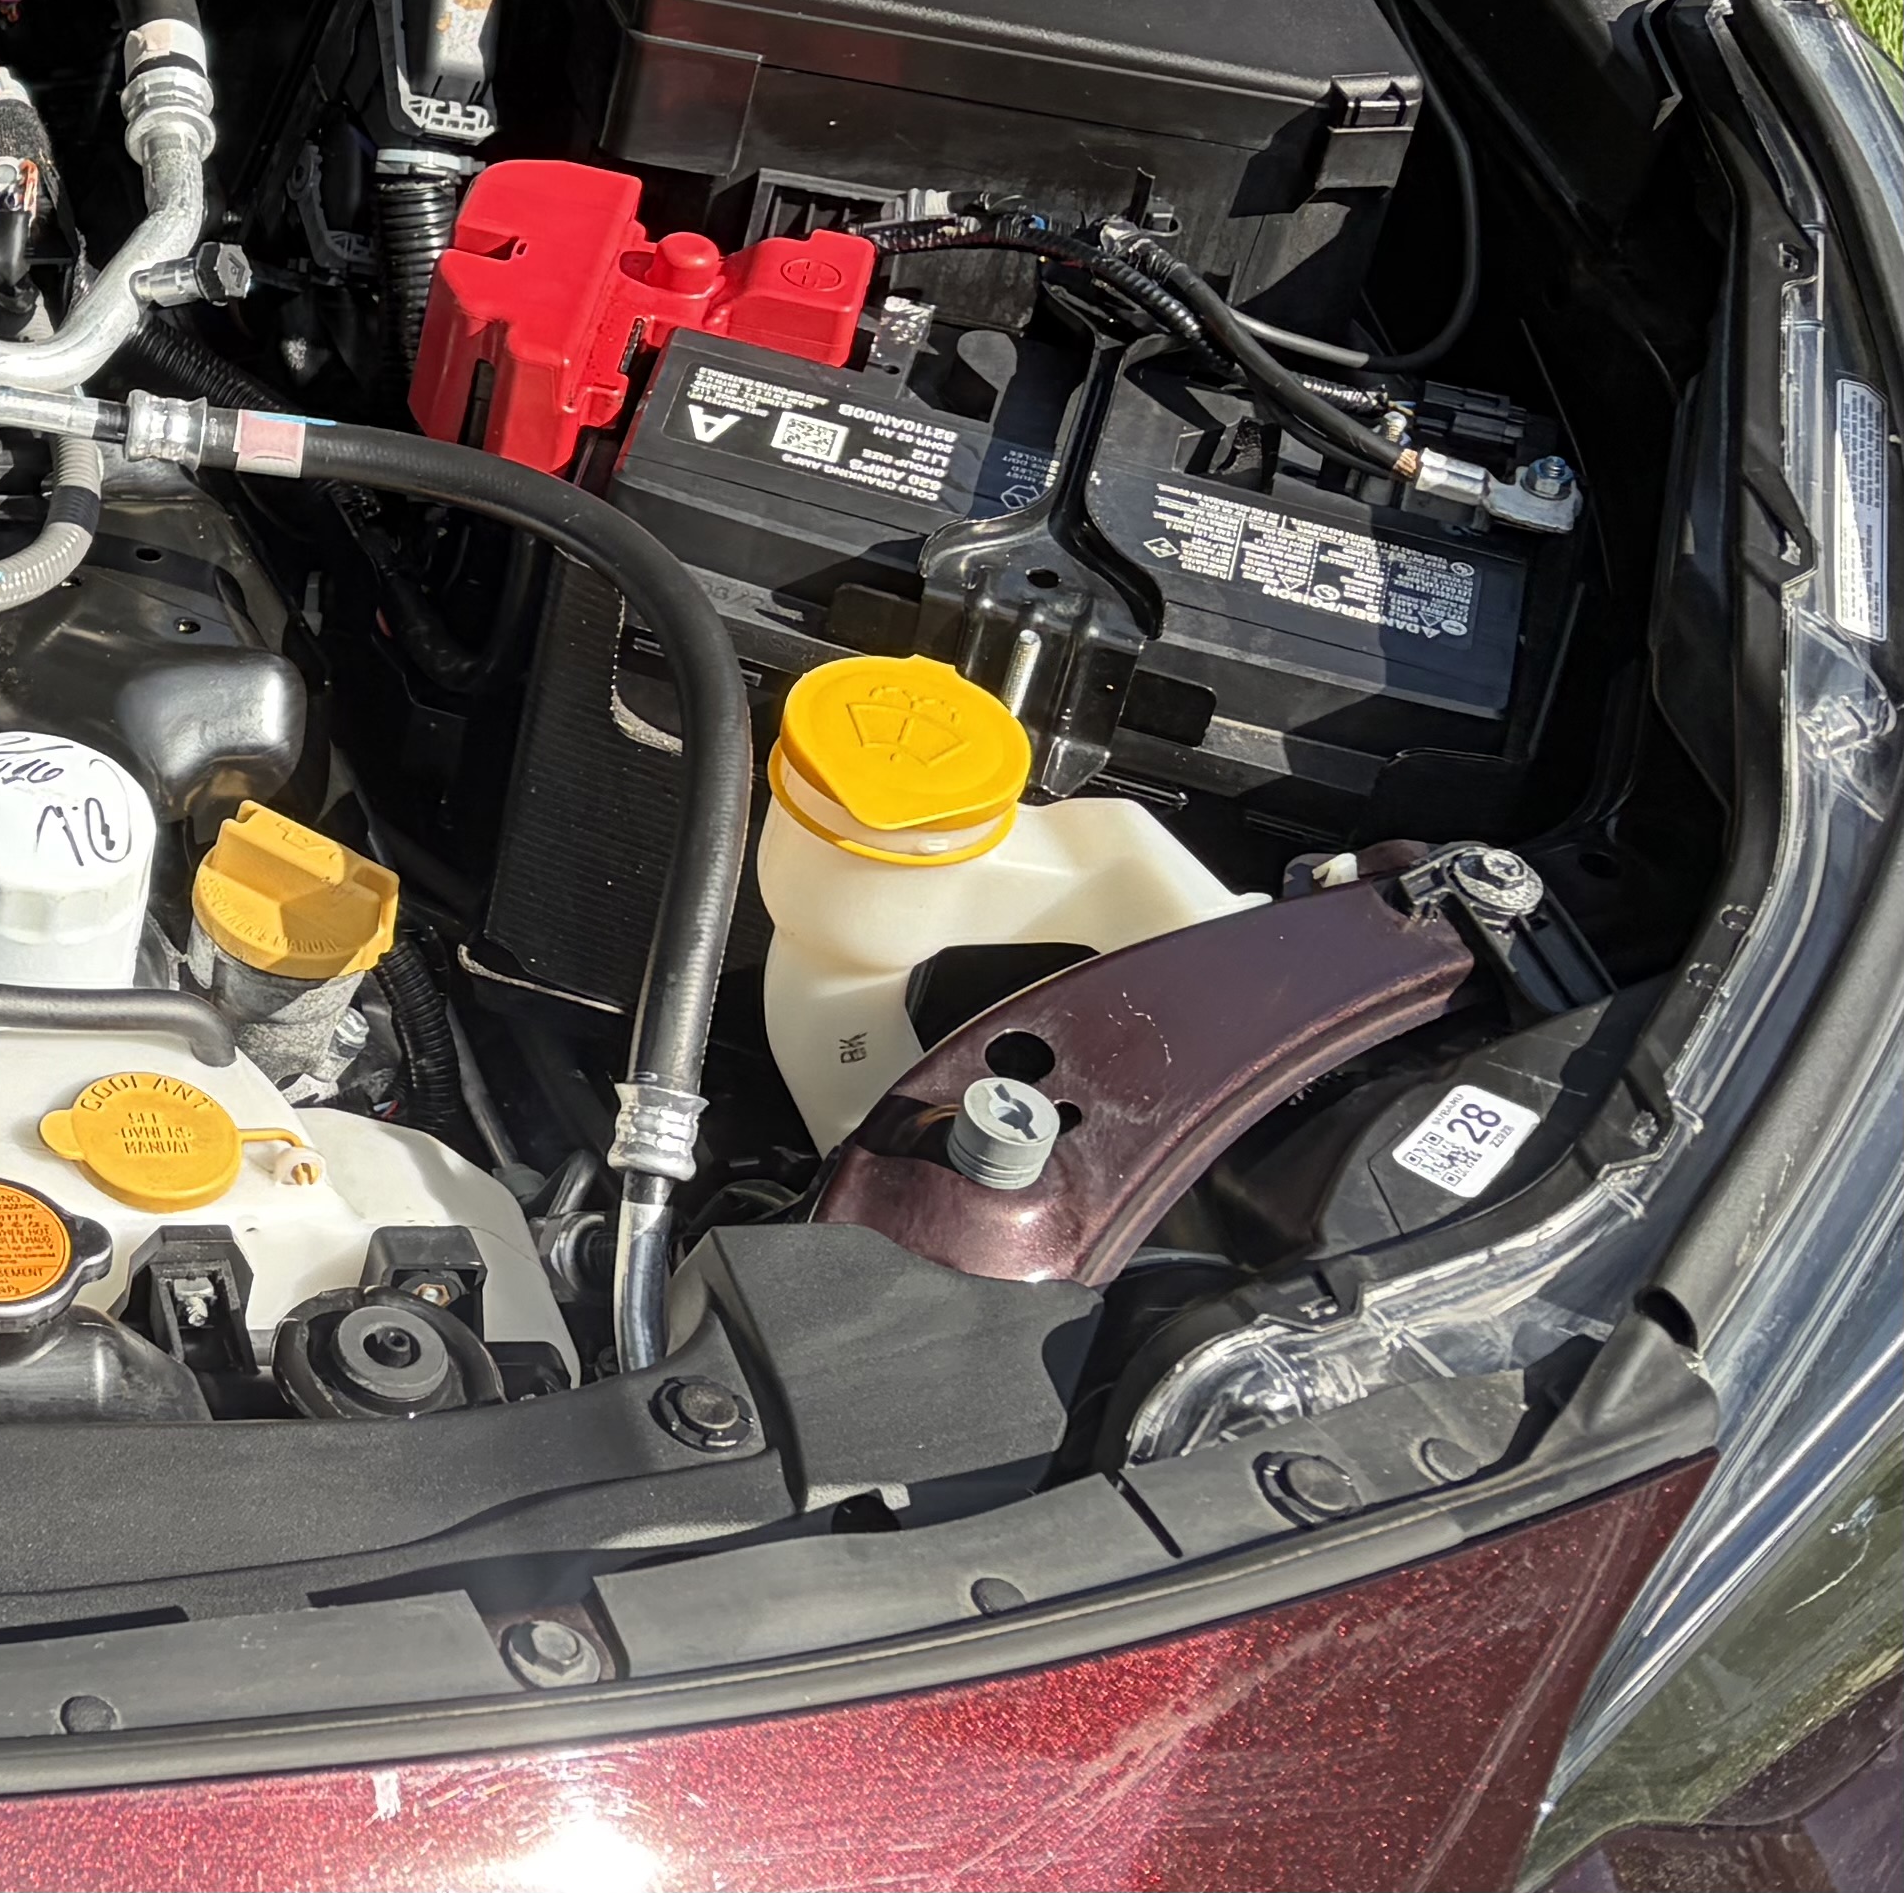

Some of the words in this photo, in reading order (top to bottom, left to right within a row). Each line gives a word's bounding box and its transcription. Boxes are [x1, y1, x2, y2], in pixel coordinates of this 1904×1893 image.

[688, 403, 742, 442] A
[823, 464, 896, 490] CRANKING
[847, 457, 905, 481] AMPS
[893, 457, 946, 478] GROUP
[897, 483, 938, 501] COLD
[907, 473, 942, 491] 620
[1261, 582, 1420, 635] DANGER/POISON
[839, 1031, 868, 1064] BK
[80, 1075, 214, 1112] COOLANT
[1447, 1103, 1502, 1145] 28
[124, 1140, 190, 1154] MANUAL
